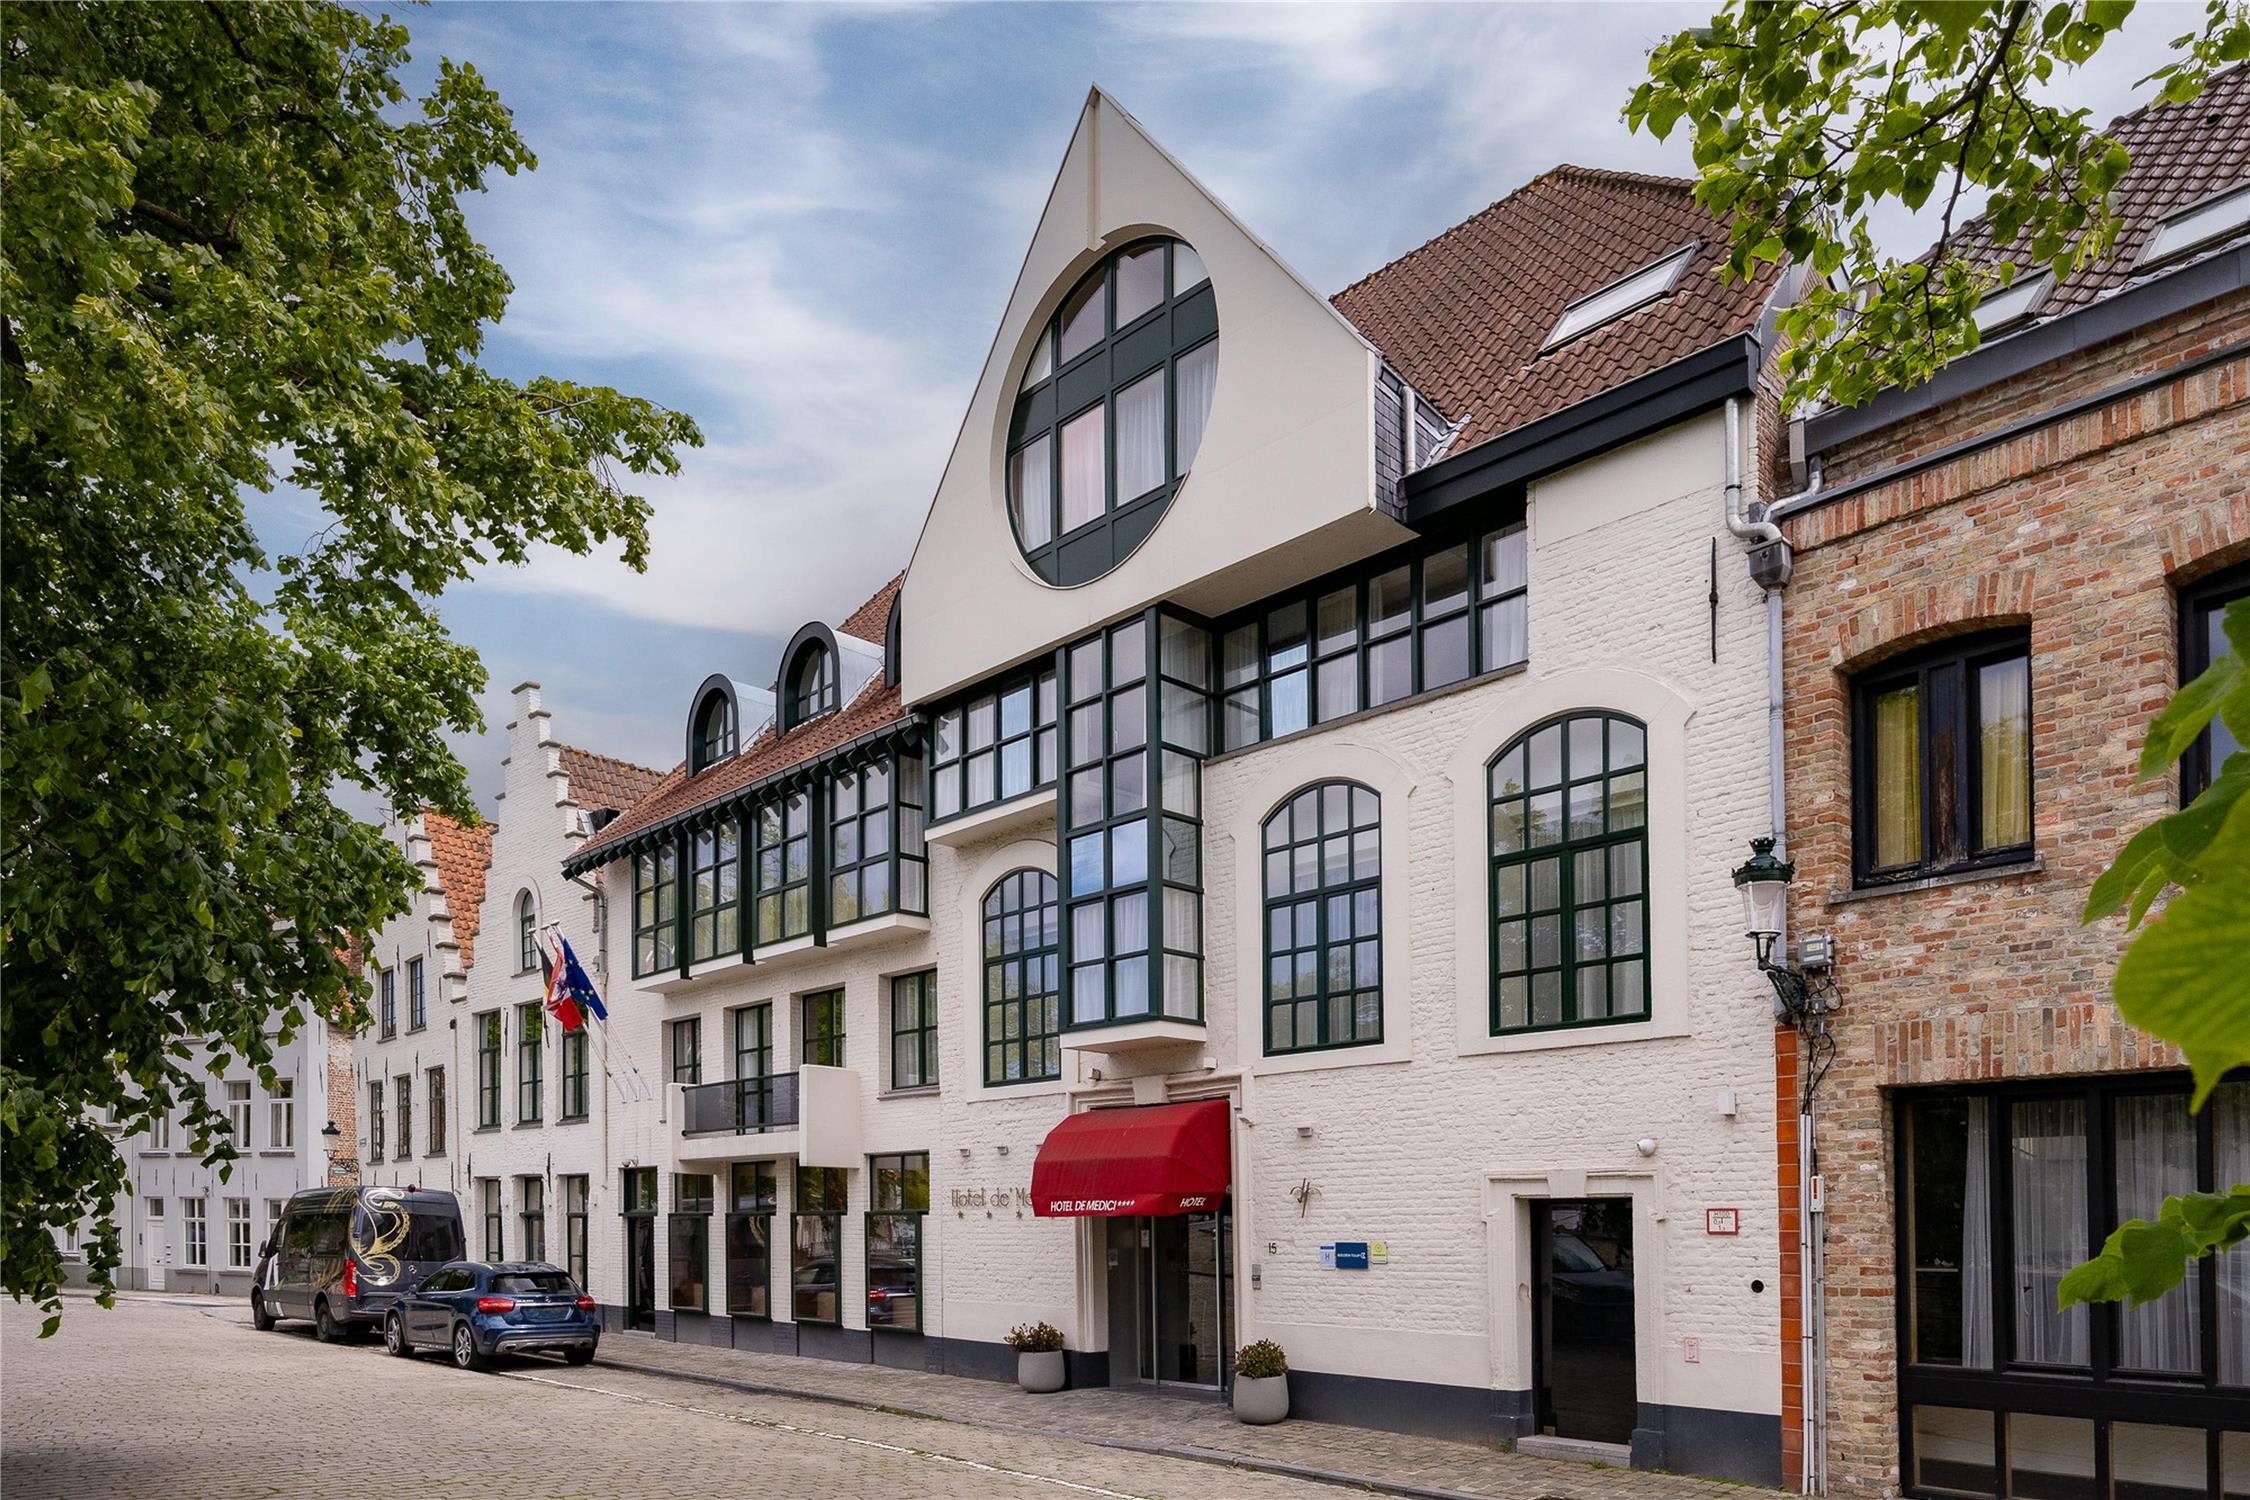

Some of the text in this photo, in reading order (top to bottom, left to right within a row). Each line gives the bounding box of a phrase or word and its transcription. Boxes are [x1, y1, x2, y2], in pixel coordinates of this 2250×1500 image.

[951, 1187, 986, 1207] Hotel
[1015, 1187, 1032, 1207] Me
[1180, 1197, 1206, 1208] HOTEL
[1050, 1199, 1117, 1212] HOTEL DE MEDICI
[1268, 1242, 1277, 1255] 15
